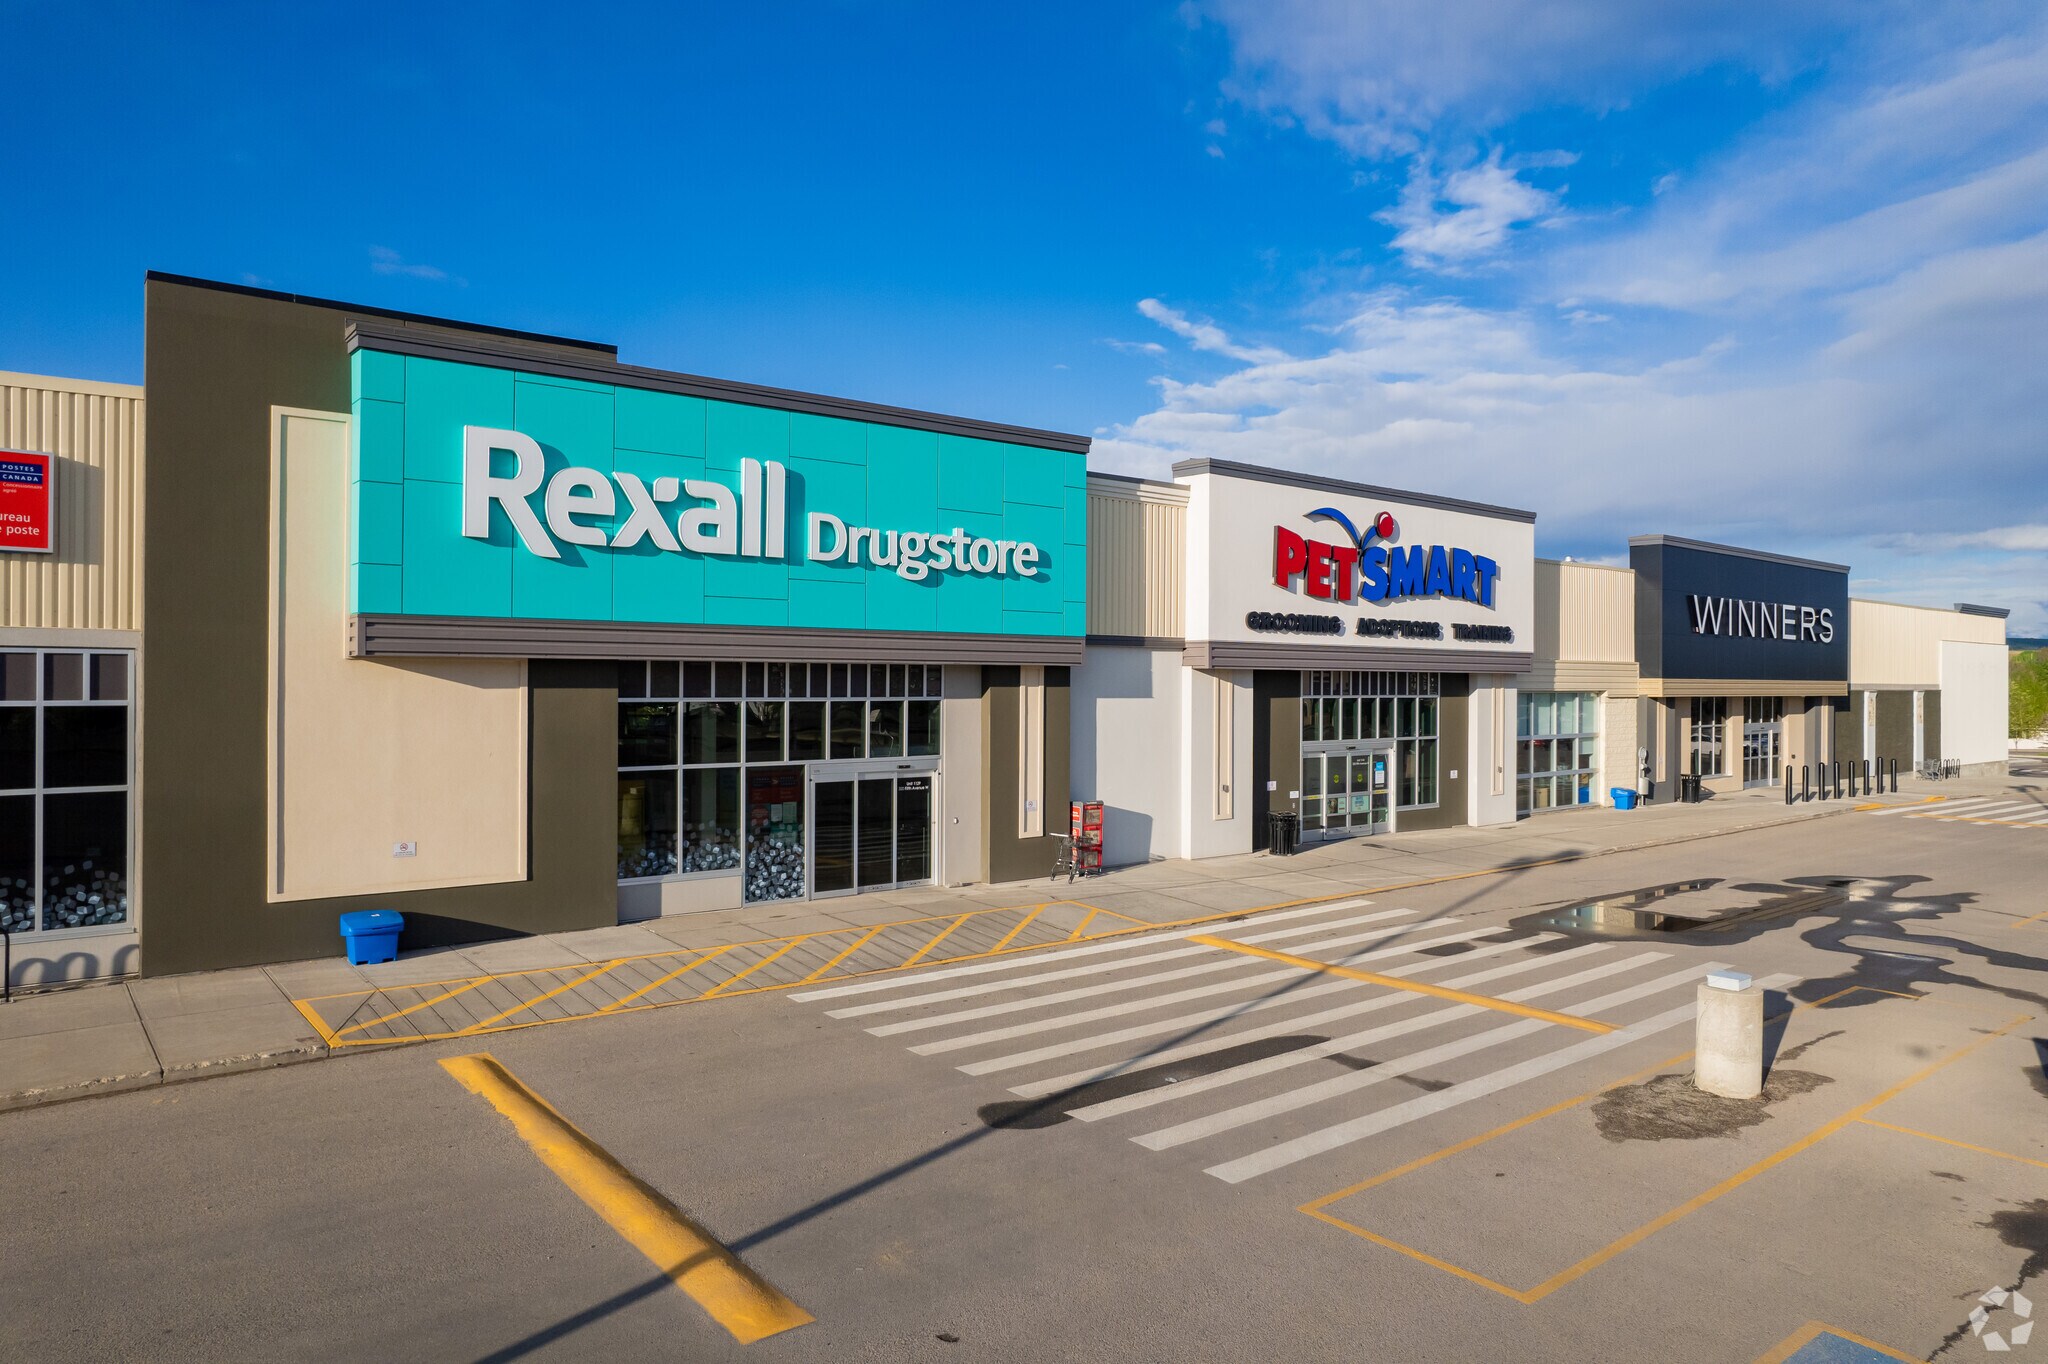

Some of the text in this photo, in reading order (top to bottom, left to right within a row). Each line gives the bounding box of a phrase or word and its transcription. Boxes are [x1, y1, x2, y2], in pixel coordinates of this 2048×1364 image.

[2, 464, 34, 472] POSTES
[2, 474, 39, 482] CANADA
[462, 425, 1039, 581] Rexall Drugstore
[6, 526, 40, 536] poste
[1272, 525, 1497, 607] PETSMART
[1246, 611, 1513, 642] GROOMING ADOPTIONS TRAINING
[1693, 594, 1834, 644] WINNERS
